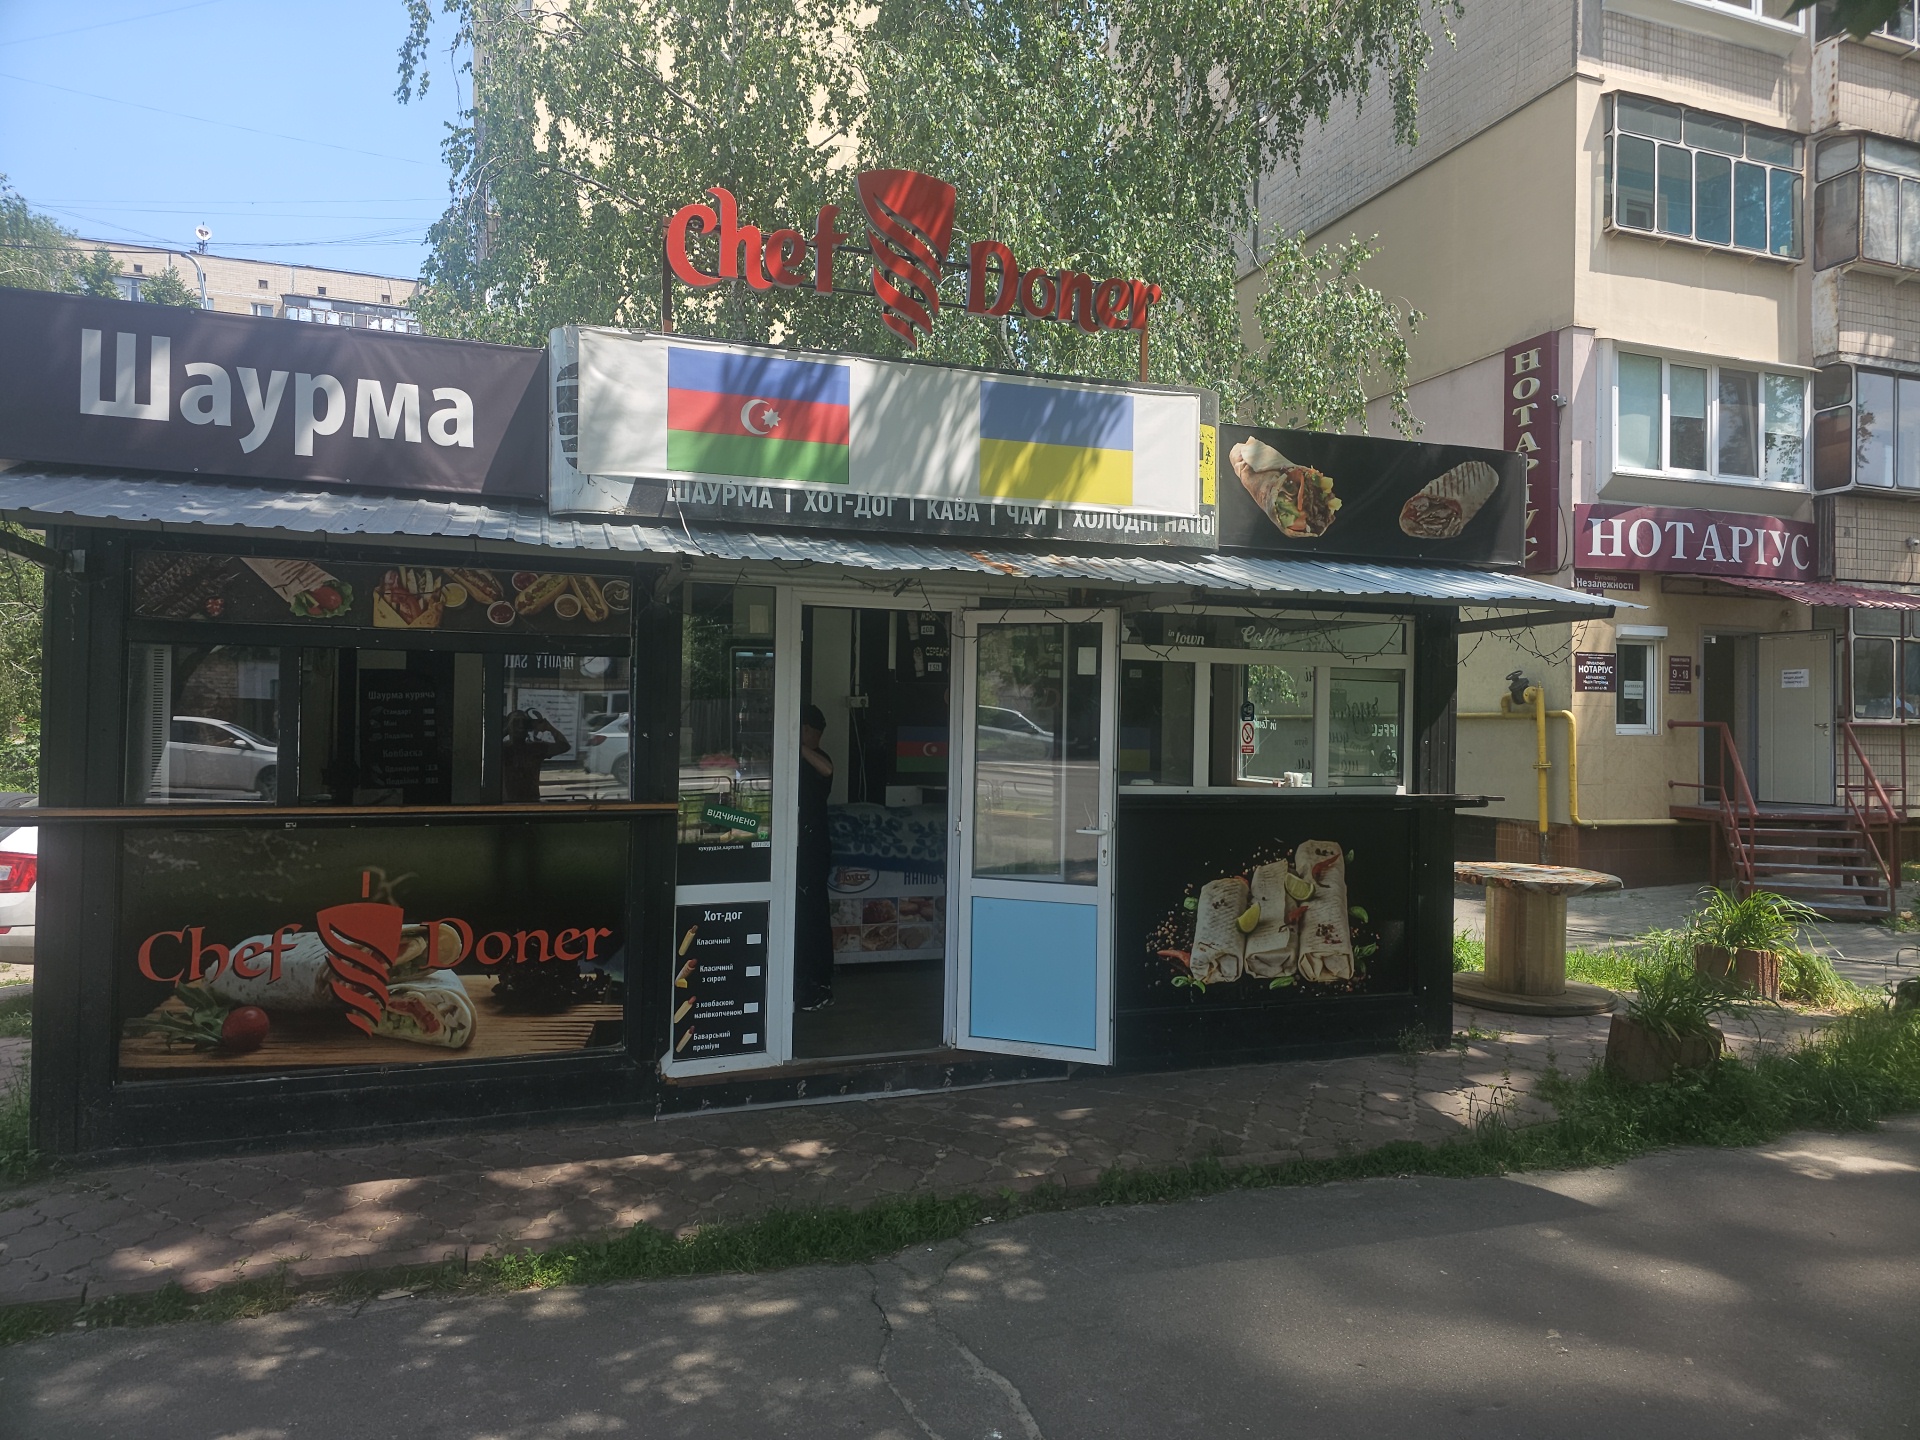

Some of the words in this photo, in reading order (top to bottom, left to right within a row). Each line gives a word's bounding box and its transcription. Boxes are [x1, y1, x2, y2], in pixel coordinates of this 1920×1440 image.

[665, 186, 851, 296] Chef
[965, 239, 1162, 333] Doner
[79, 327, 477, 457] Шаурма
[666, 479, 774, 510] ШАУРМА
[803, 489, 899, 519] ХОТ-ДОГ
[926, 498, 980, 523] КАВА
[1586, 517, 1811, 571] НОТАРІУС
[1575, 577, 1635, 590] Незалежності
[1175, 631, 1206, 646] town
[1240, 626, 1290, 649] Coffee
[1578, 665, 1614, 675] НОТАРІУС
[368, 690, 404, 702] Шаурма
[706, 808, 757, 827] ВІДЧИНЕНО
[703, 910, 743, 922] Хот-дог
[696, 936, 731, 946] Класичний
[137, 920, 303, 985] Chef
[418, 915, 613, 970] Doner
[699, 963, 734, 973] Класичний
[706, 975, 727, 984] сиром
[700, 999, 735, 1009] ковбаскою
[694, 1009, 743, 1020] напівкопченою
[693, 1030, 731, 1041] Баварський
